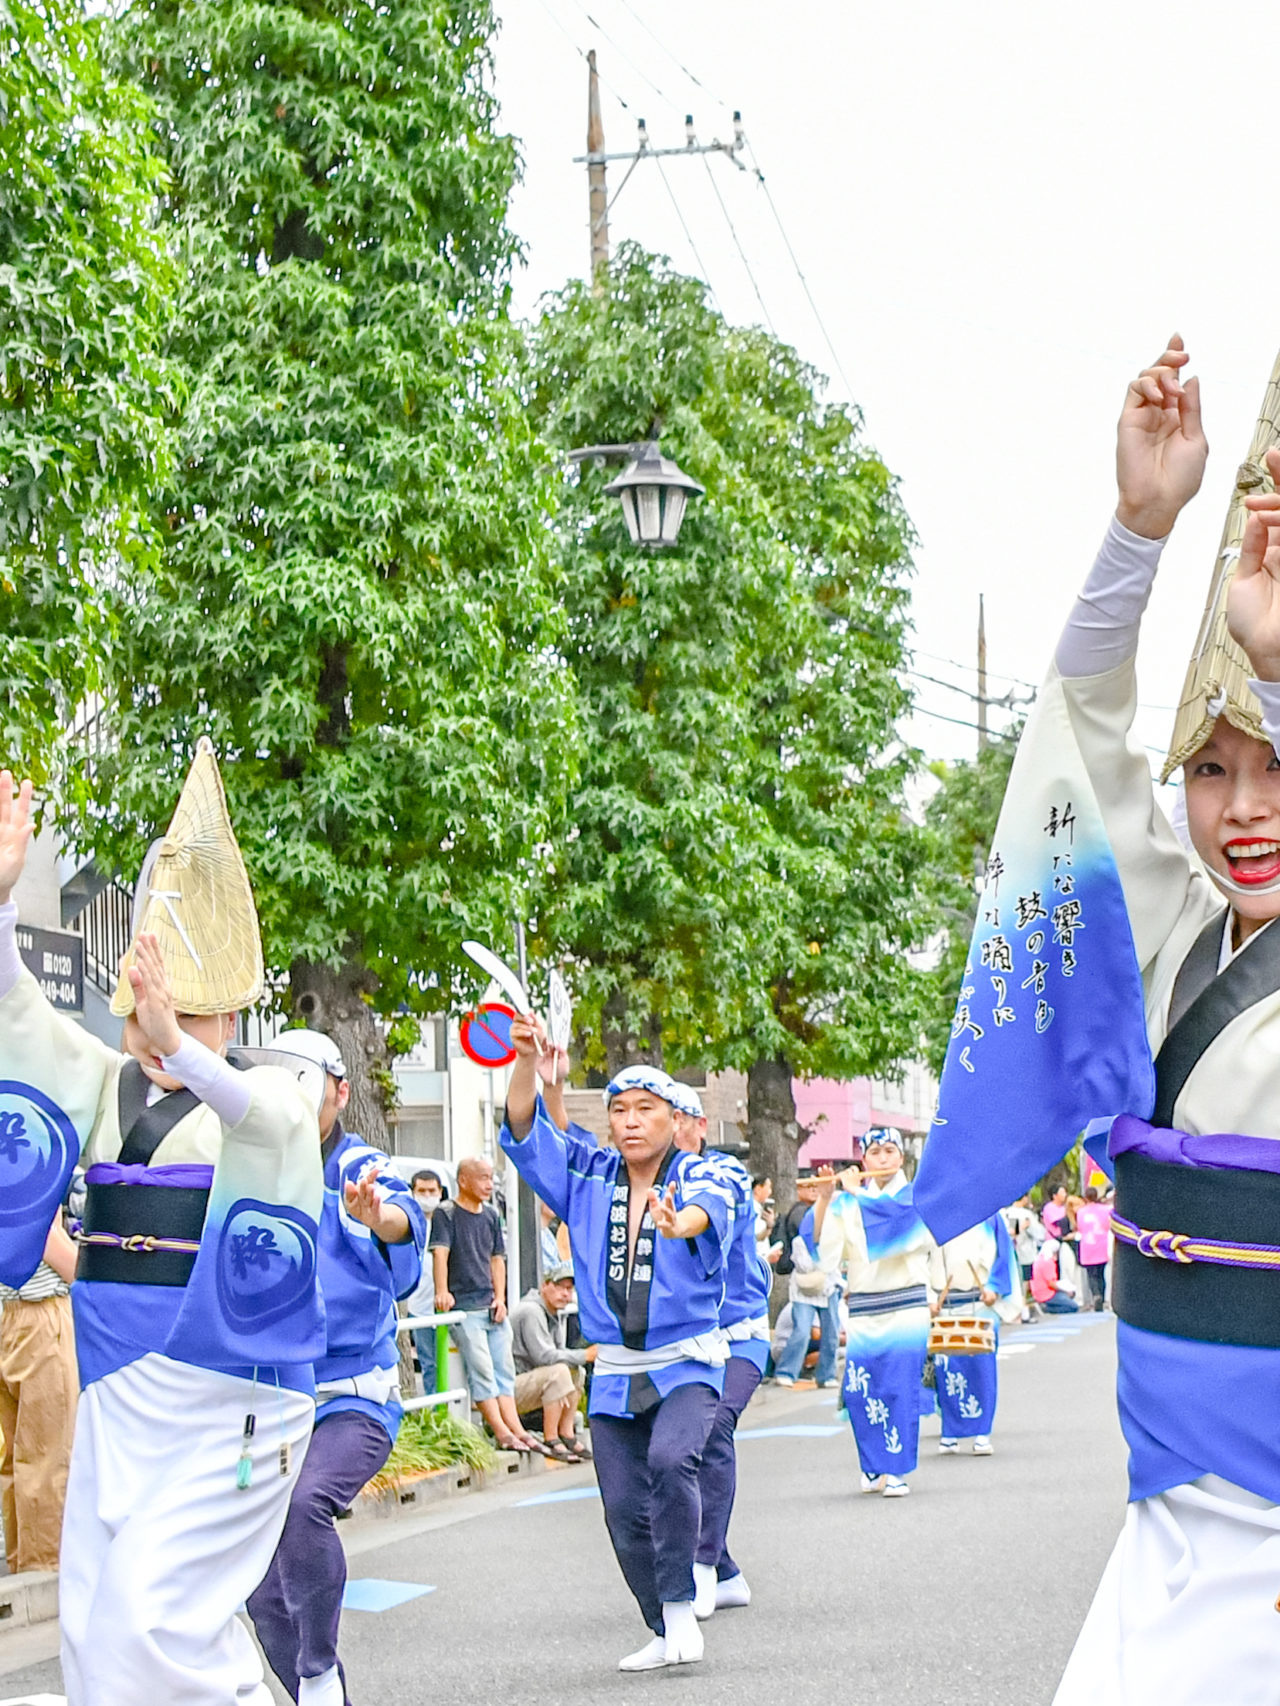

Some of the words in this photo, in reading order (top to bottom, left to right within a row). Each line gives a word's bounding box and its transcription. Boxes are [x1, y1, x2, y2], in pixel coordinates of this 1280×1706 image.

[54, 954, 72, 977] 0120
[608, 1185, 629, 1281] 阿波おどり
